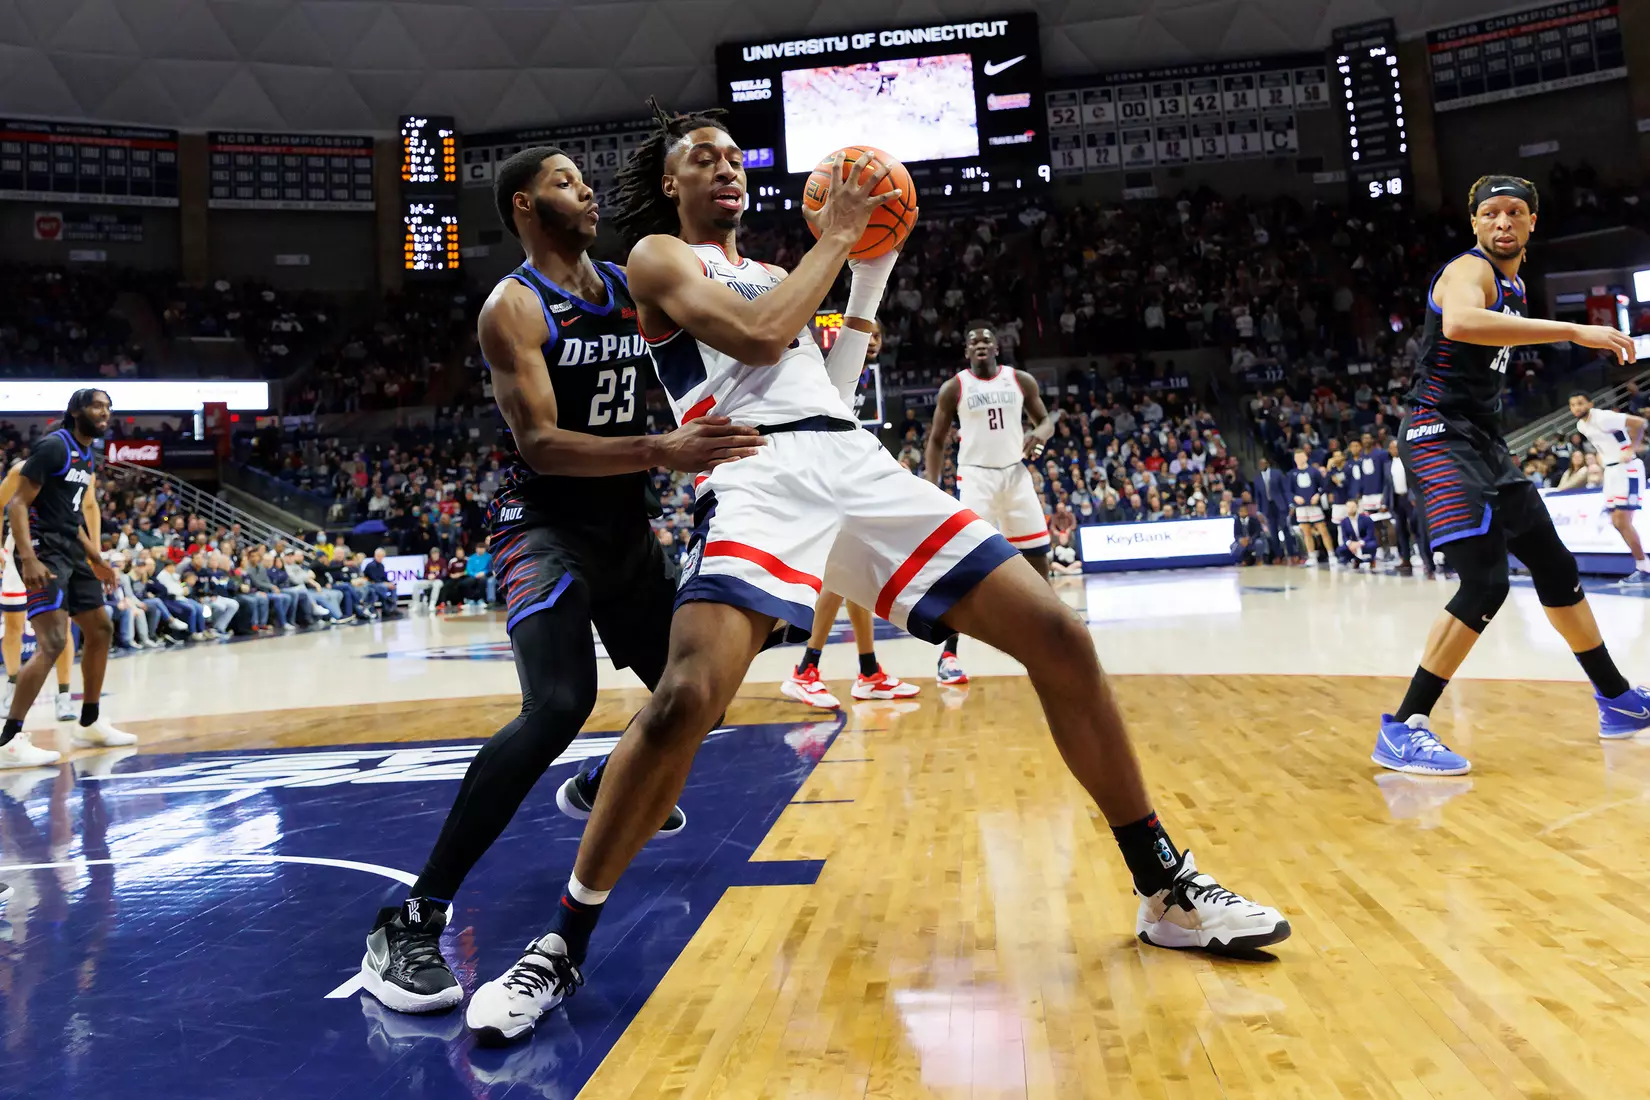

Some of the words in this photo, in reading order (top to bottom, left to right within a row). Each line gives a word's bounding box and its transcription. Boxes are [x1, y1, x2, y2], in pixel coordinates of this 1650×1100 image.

[743, 35, 848, 62] UNIVERSITY
[851, 33, 876, 50] OF
[879, 20, 1009, 47] CONNECTICUT
[1122, 102, 1146, 118] 00
[1159, 98, 1179, 114] 13
[1193, 95, 1217, 111] 42
[1053, 108, 1076, 124] 52
[1201, 137, 1217, 154] 13
[1272, 130, 1289, 149] C
[594, 152, 617, 167] 42
[470, 164, 485, 179] C
[1037, 164, 1051, 183] 9
[587, 365, 637, 427] 23
[967, 391, 1016, 410] CONNECTICUT
[987, 407, 1005, 431] 21
[72, 486, 85, 513] 4
[1106, 532, 1173, 547] KeyBank
[384, 569, 421, 583] ONN
